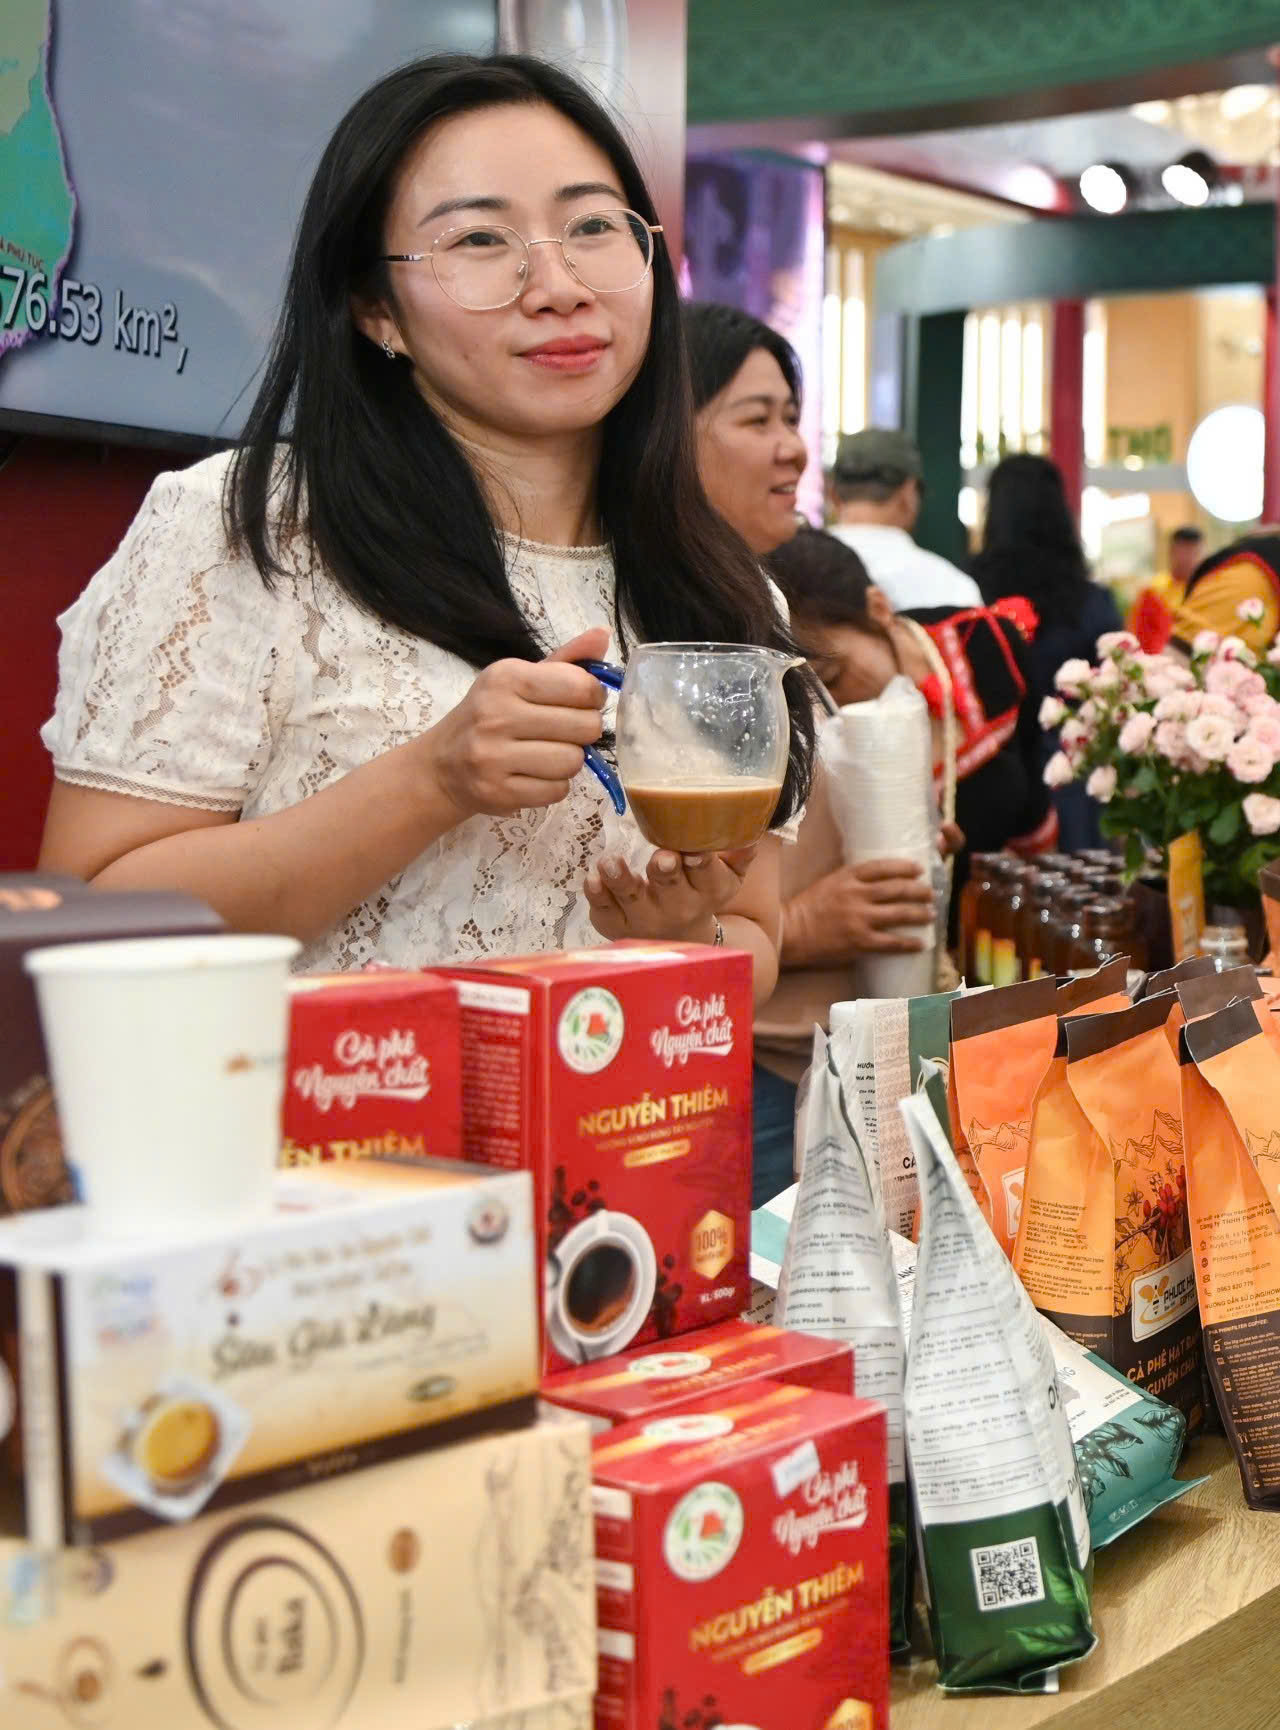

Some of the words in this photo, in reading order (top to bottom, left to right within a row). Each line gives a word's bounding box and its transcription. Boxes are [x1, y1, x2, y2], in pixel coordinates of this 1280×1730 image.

[677, 995, 702, 1027] Cà
[702, 993, 726, 1028] phê
[335, 1030, 376, 1067] Cà
[377, 1028, 416, 1069] phê
[651, 1026, 703, 1068] Nguyên
[294, 1063, 380, 1113] Nguyên
[1147, 1348, 1168, 1376] PHÊ
